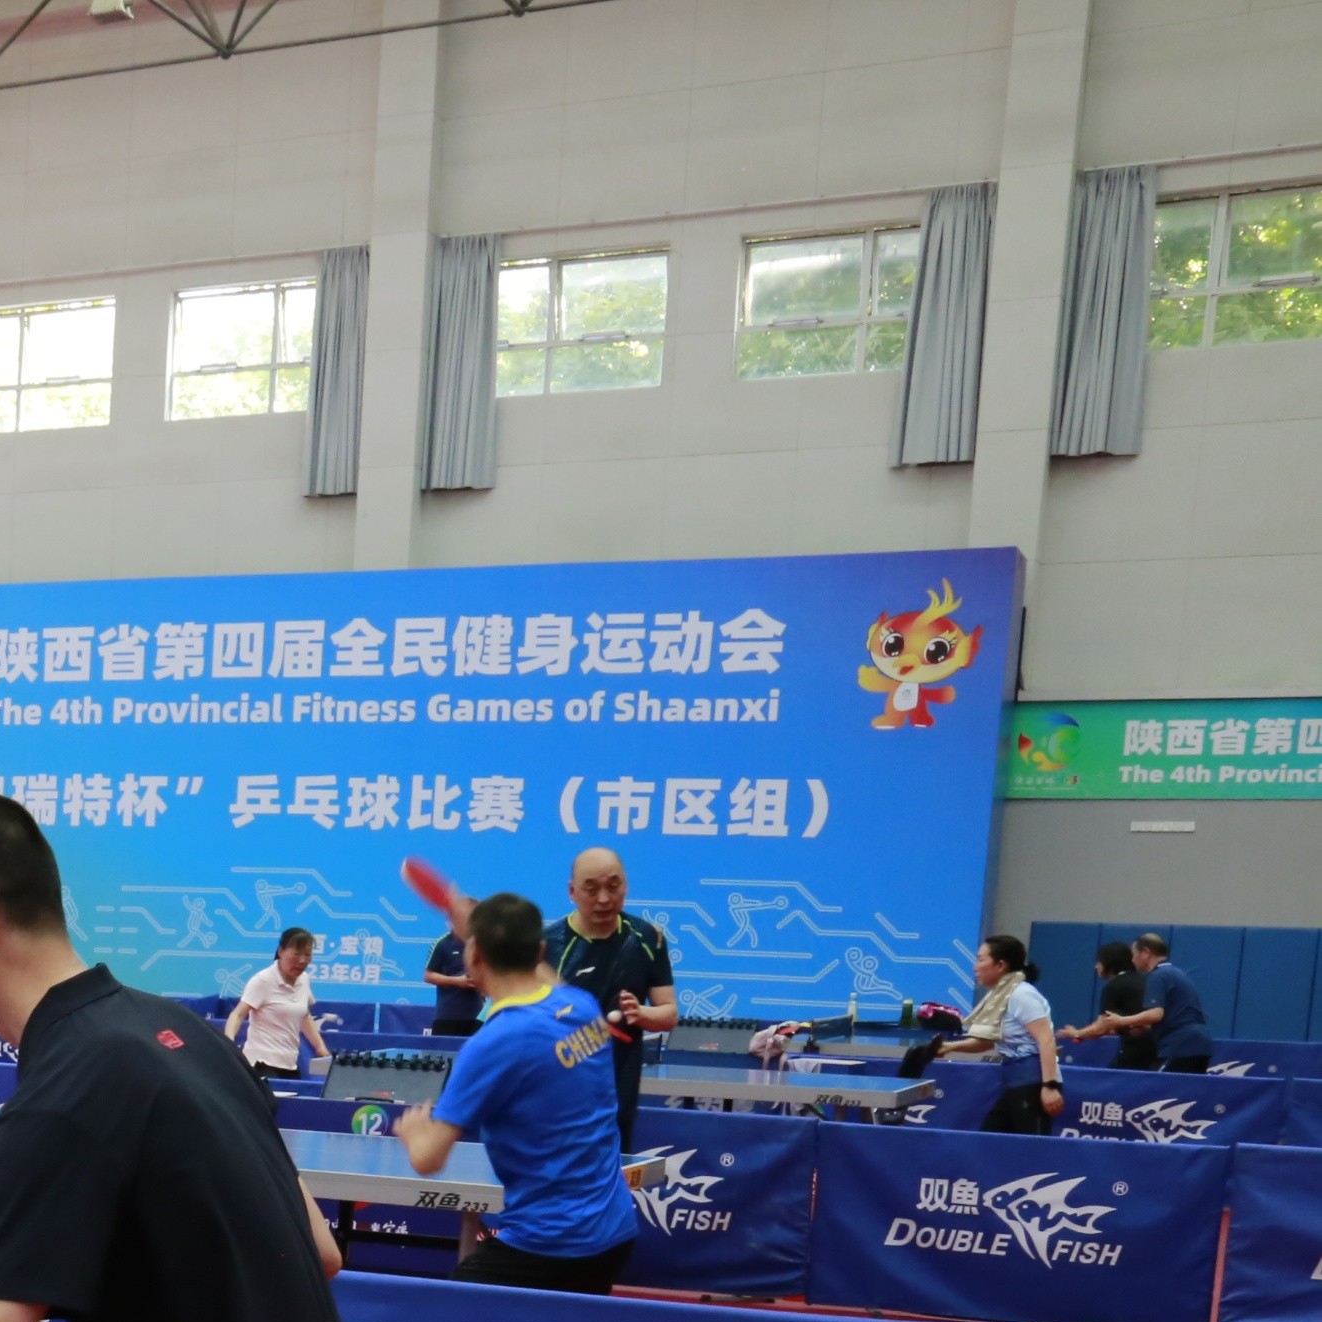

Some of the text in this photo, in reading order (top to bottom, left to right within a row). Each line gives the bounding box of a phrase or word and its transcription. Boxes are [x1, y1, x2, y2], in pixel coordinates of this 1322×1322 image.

[50, 696, 103, 726] 4th
[113, 693, 283, 725] Provincial
[292, 691, 416, 724] Fitness
[427, 693, 554, 723] Games
[564, 690, 606, 723] of
[613, 688, 780, 723] Shaanxi
[1119, 765, 1164, 784] The
[1169, 765, 1212, 784] 4th
[358, 1112, 383, 1136] 12
[414, 1191, 461, 1209] 双鱼
[462, 1201, 489, 1213] 233
[669, 1208, 732, 1232] FISH
[883, 1217, 1123, 1268] DOUBLE FISH
